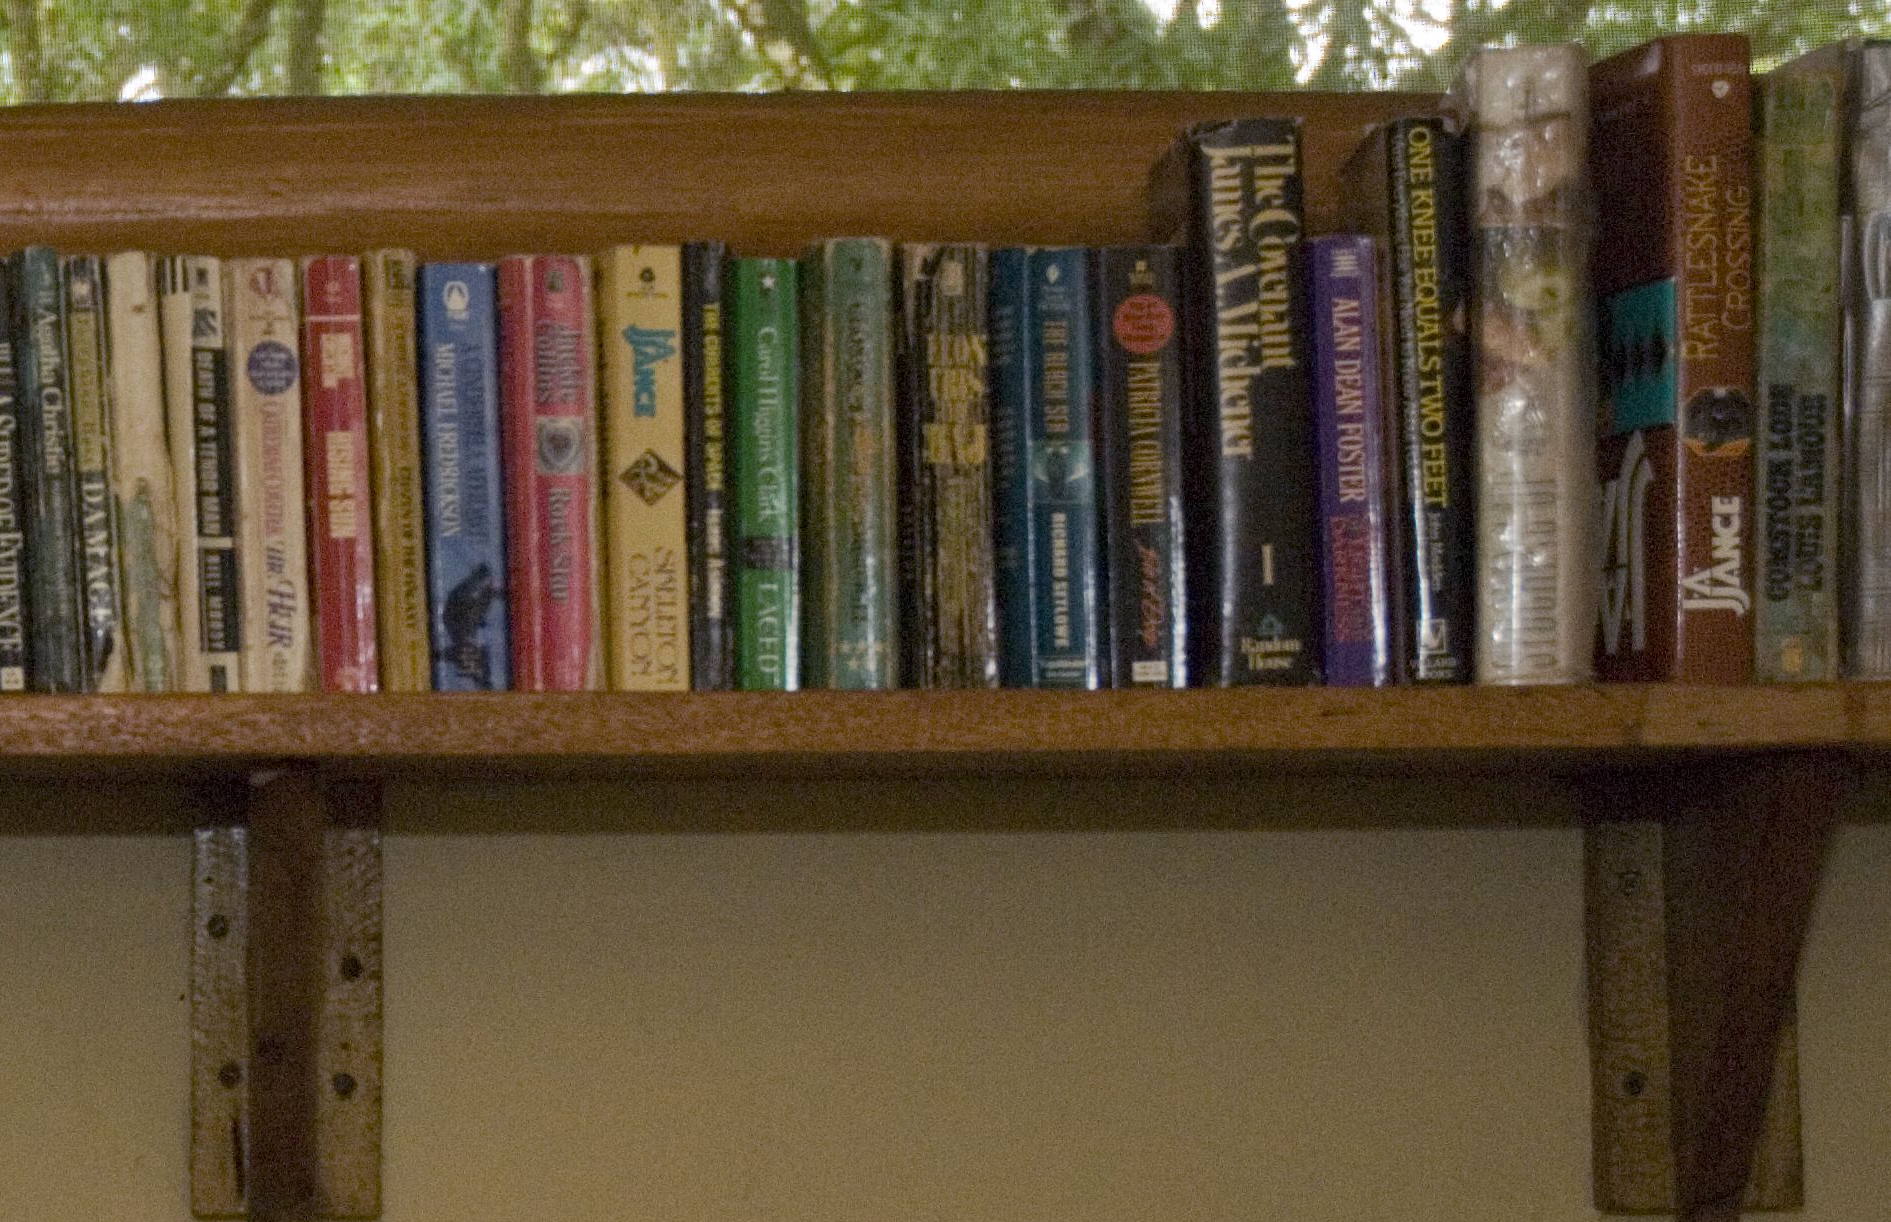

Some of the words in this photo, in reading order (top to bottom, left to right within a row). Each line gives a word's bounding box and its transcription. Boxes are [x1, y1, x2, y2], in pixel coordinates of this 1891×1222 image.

[1256, 136, 1297, 207] The
[1408, 126, 1432, 182] ONE
[1200, 144, 1255, 250] James
[1411, 188, 1436, 261] KNEE
[1215, 256, 1257, 296] A.
[1249, 208, 1301, 368] Covenant
[1682, 154, 1718, 362] RATTLESNAKE
[1721, 185, 1750, 331] CROSSING
[35, 306, 63, 385] Agatha
[754, 326, 780, 382] Carol
[1043, 319, 1069, 346] THE
[1331, 297, 1362, 353] ALAN
[1413, 267, 1440, 372] EQUALS
[433, 342, 459, 417] MICHAEL
[1043, 350, 1069, 397] BLACK
[1128, 361, 1163, 437] PATRICIA
[1217, 297, 1258, 460] Michener
[1336, 359, 1363, 416] DEAN
[1419, 373, 1443, 437] TWO
[38, 387, 63, 475] Christie
[752, 386, 781, 463] Higgins
[1045, 399, 1070, 433] SEA
[325, 430, 355, 497] RISING
[437, 422, 462, 538] FREDRICKSON
[756, 466, 783, 523] Clark
[1129, 439, 1165, 526] CORNWELL
[1338, 423, 1366, 503] FOSTER
[1421, 442, 1448, 508] FEET
[81, 482, 109, 627] DAMAGE
[328, 499, 358, 539] SUN
[627, 552, 653, 678] CANYON
[653, 546, 679, 685] SKELETON
[758, 582, 781, 675] LACED
